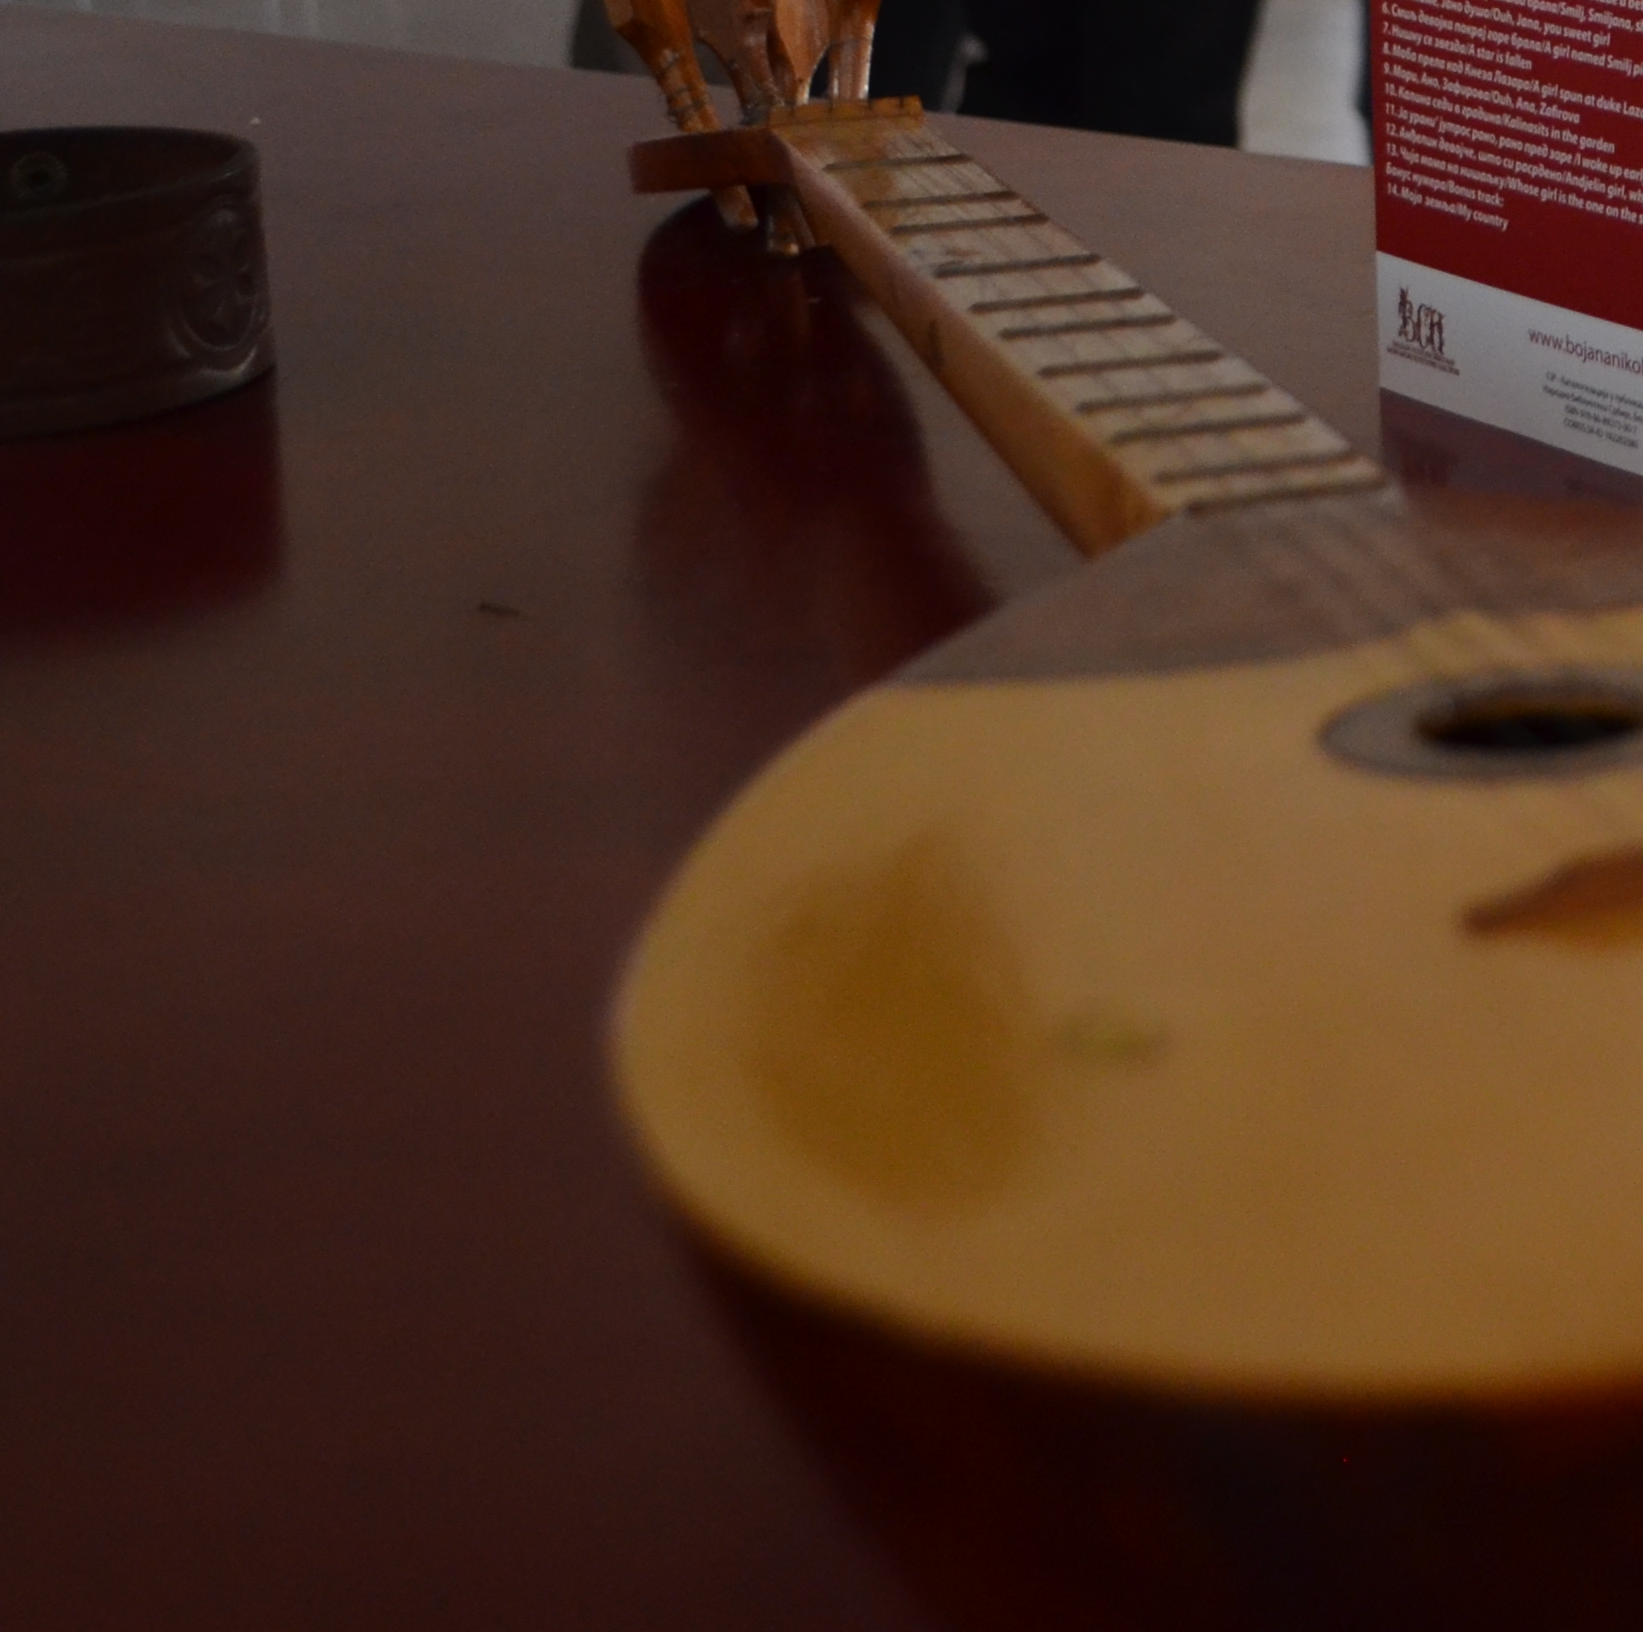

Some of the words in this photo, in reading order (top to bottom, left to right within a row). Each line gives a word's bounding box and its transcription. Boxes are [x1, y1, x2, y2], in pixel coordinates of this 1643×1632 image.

[1587, 7, 1634, 32] Smiljana,
[1542, 22, 1563, 36] you
[1562, 26, 1592, 43] sweet
[1592, 31, 1611, 48] girl
[1475, 47, 1496, 61] star
[1495, 52, 1505, 64] is
[1504, 51, 1533, 70] fallen
[1552, 43, 1571, 60] girl
[1570, 49, 1607, 67] named
[1606, 54, 1633, 77] Smilj
[1540, 83, 1559, 99] girl
[1558, 88, 1584, 104] spun
[1583, 94, 1596, 107] at
[1595, 95, 1622, 113] duke
[1538, 101, 1581, 125] Zafirova
[1550, 125, 1561, 140] in
[1561, 129, 1579, 145] the
[1579, 135, 1615, 154] garden
[1581, 157, 1609, 174] woke
[1608, 164, 1623, 179] up
[1540, 186, 1558, 203] girl
[1557, 189, 1567, 205] is
[1567, 193, 1585, 209] the
[1584, 200, 1605, 214] one
[1605, 205, 1620, 218] on
[1620, 206, 1638, 223] the
[1606, 183, 1627, 201] girl,
